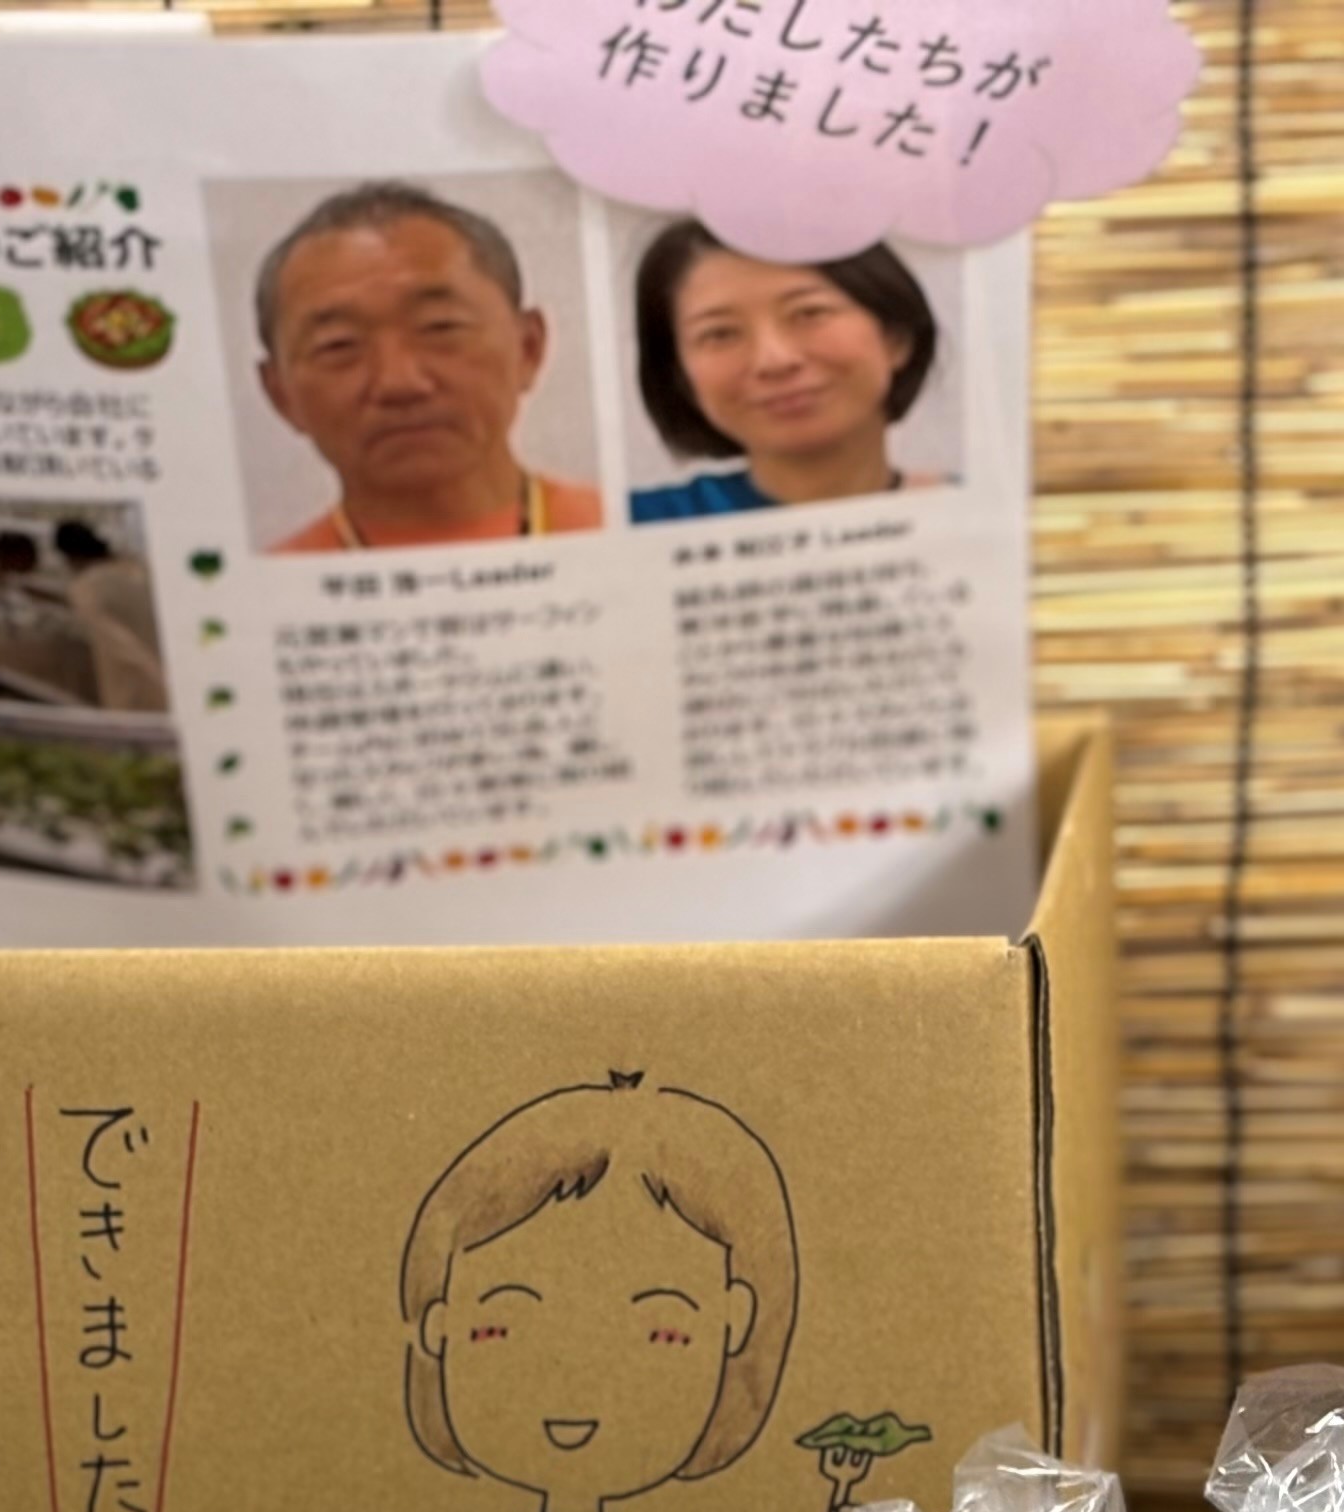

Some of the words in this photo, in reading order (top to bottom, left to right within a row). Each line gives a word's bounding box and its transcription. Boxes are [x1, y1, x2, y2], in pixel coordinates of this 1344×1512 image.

[636, 0, 1052, 99] たしたちが
